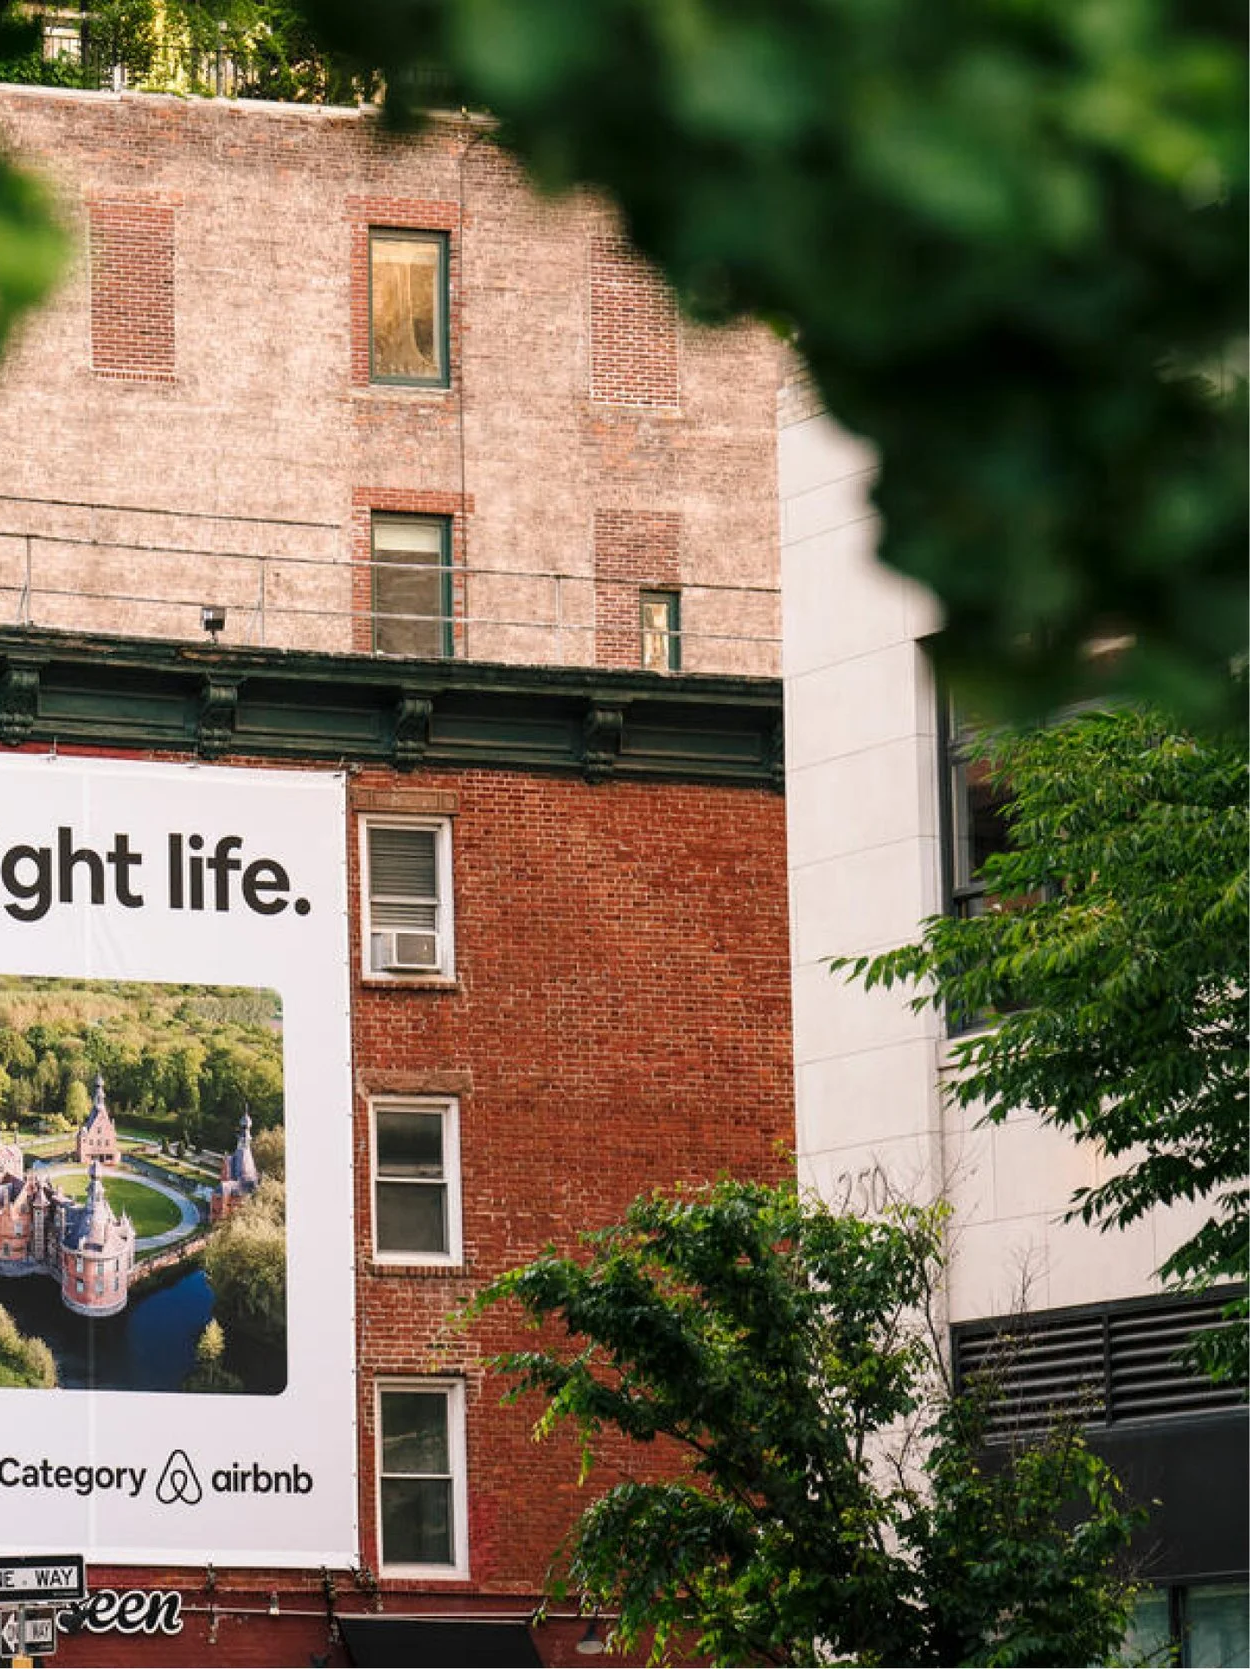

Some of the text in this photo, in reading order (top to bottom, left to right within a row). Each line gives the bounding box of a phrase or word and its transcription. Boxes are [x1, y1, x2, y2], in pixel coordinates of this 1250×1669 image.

[168, 832, 311, 917] life.
[836, 1165, 888, 1218] 250
[211, 1461, 313, 1494] airbnb
[34, 1567, 73, 1587] WAY
